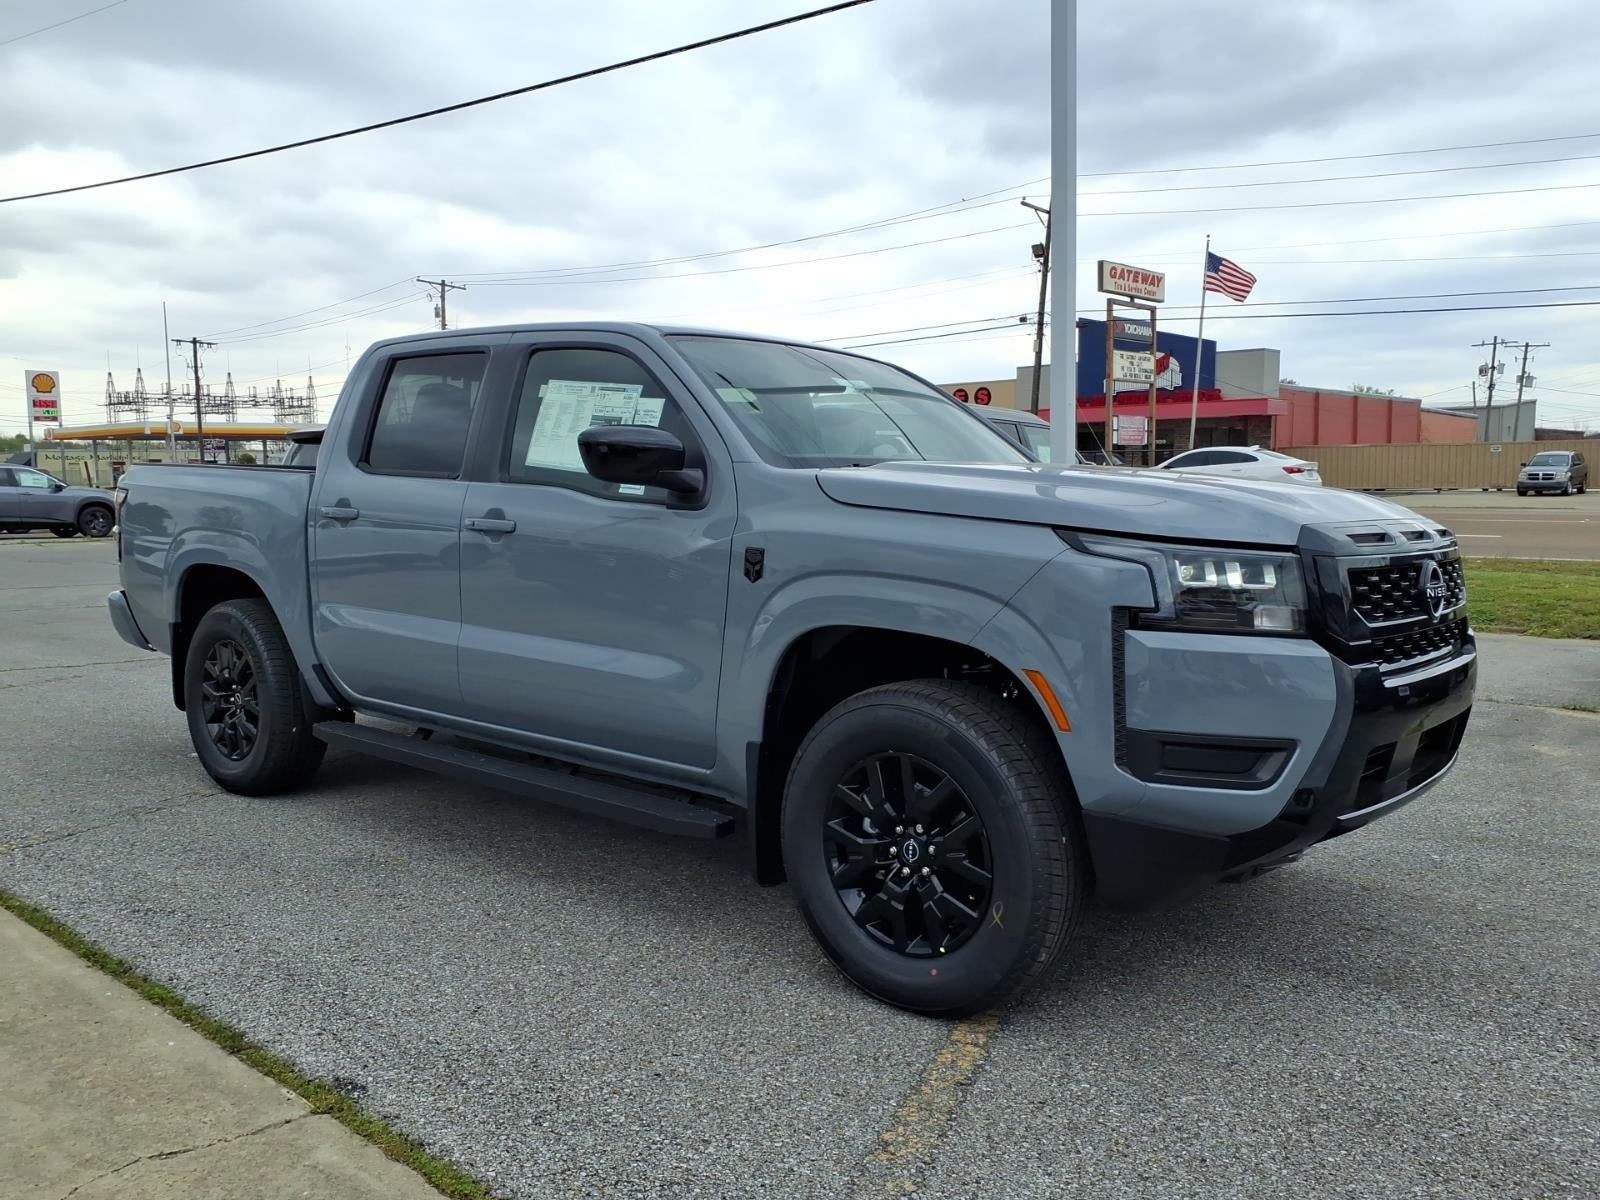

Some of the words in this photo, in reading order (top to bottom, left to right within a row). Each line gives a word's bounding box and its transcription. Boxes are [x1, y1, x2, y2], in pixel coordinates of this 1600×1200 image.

[1110, 266, 1163, 287] GATEWAY
[1114, 281, 1123, 291] Tire
[1124, 323, 1153, 337] YOKOHAMA
